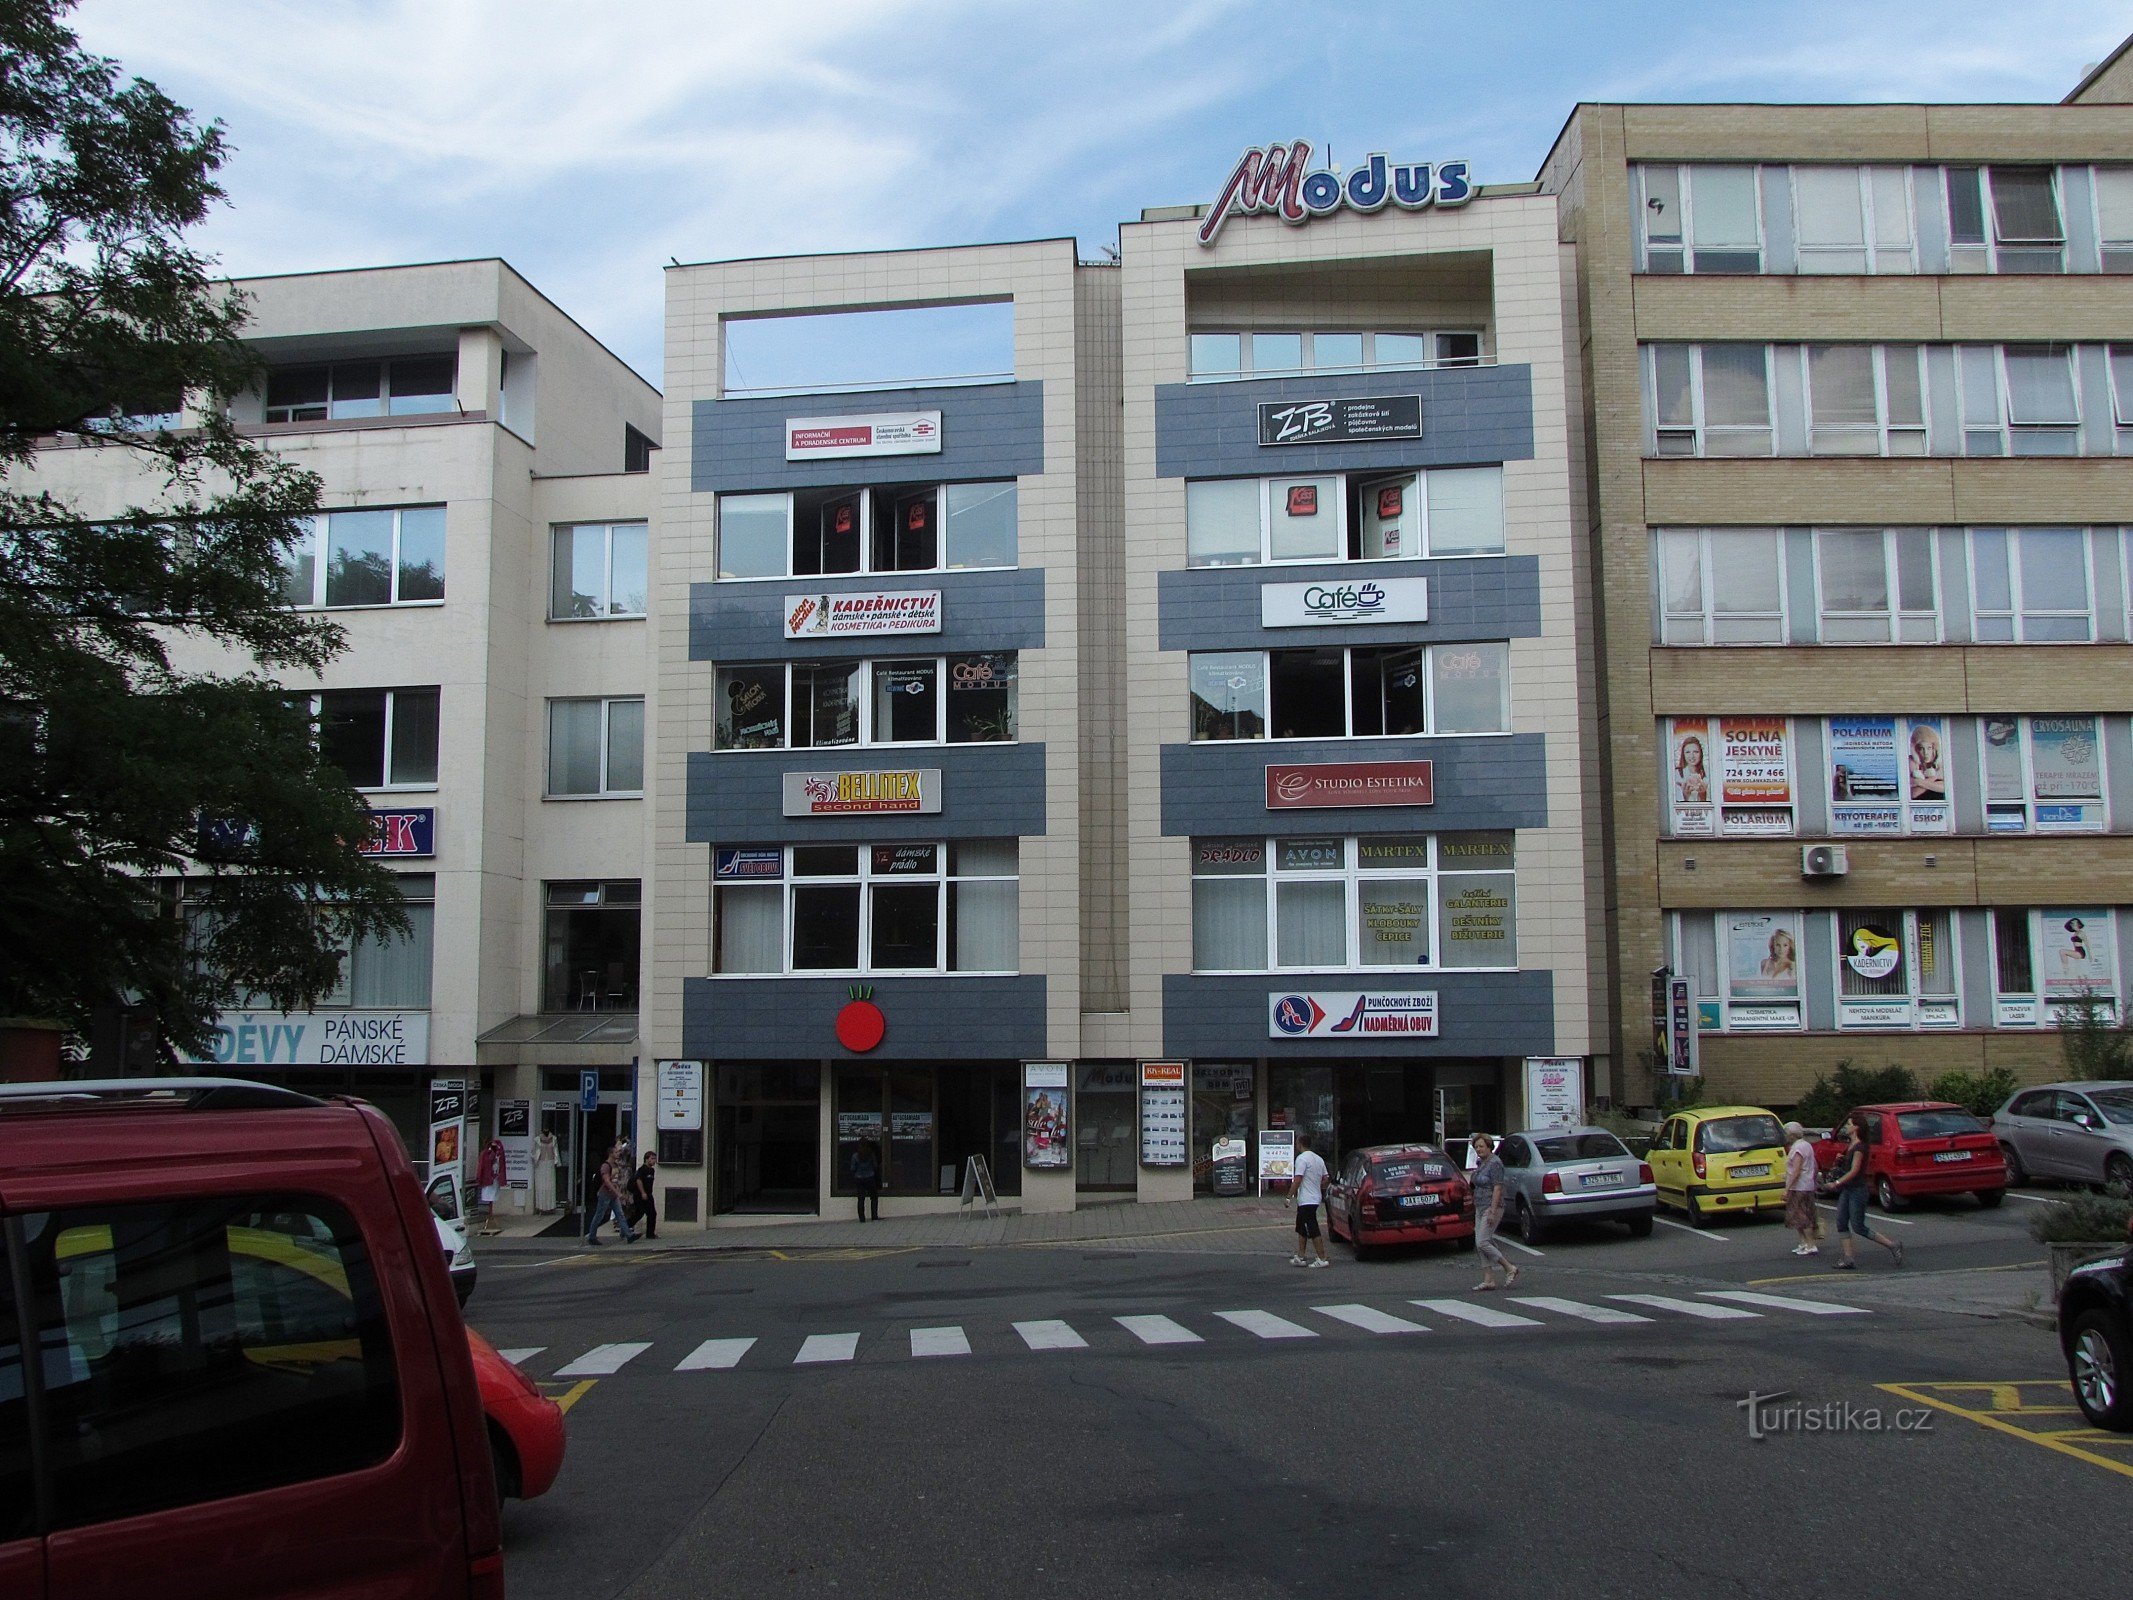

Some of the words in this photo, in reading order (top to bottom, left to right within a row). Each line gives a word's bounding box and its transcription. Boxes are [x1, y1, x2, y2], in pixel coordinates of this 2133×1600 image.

[1198, 138, 1472, 248] Modus
[1348, 403, 1375, 412] prodejna
[1381, 410, 1390, 418] šití
[1271, 402, 1333, 442] ZB
[1348, 419, 1377, 427] půjčovna
[1348, 425, 1394, 435] společenských
[1394, 423, 1418, 431] modelů
[795, 432, 831, 440] INFORMAČNÍ
[801, 438, 838, 446] PORADENSKÉ
[832, 593, 937, 612] KADEŘNICTVÍ
[1304, 584, 1358, 610] Café
[788, 598, 809, 627] salon
[791, 600, 817, 635] Modus
[832, 611, 865, 621] dámské
[871, 611, 901, 621] pánské
[907, 610, 935, 618] dětské
[830, 621, 883, 632] KOSMETIKA
[953, 662, 993, 681] Café
[1832, 727, 1892, 738] POLÁRIUM
[2032, 720, 2093, 733] CRYOSAUNA
[1725, 727, 1782, 742] SOLNÁ
[1725, 743, 1782, 756] JESKYNĚ
[838, 772, 921, 801] BELLITEX
[1315, 778, 1363, 789] STUDIO
[1367, 777, 1424, 788] ESTETIKA
[814, 802, 873, 811] second
[879, 801, 918, 809] hand
[1834, 812, 1898, 821] KRYOTERAPIE
[1913, 814, 1944, 823] ESHOP
[896, 847, 932, 858] dámské
[1286, 848, 1337, 861] AVON
[1360, 846, 1424, 857] MARTEX
[1443, 844, 1508, 856] MARTEX
[889, 858, 918, 873] prádlo
[1446, 898, 1508, 909] GALANTERIE
[1367, 918, 1421, 929] KLOBOUKY
[1452, 914, 1503, 927] DEŠTNÍKY
[1376, 929, 1412, 941] ČEPICE
[1451, 927, 1505, 940] BIŽUTERIE
[1368, 995, 1411, 1007] PUNČOCHOVÉ
[1412, 995, 1433, 1007] ZBOŽÍ
[1363, 1014, 1409, 1032] NADMĚRNÁ
[1410, 1016, 1432, 1031] OBUV
[196, 1013, 306, 1063] DĚVY
[325, 1014, 402, 1039] PÁNSKÉ
[320, 1039, 405, 1064] DÁMSKÉ
[1082, 1066, 1133, 1089] Modu
[434, 1096, 460, 1114] ZB
[1424, 1164, 1443, 1172] BEAT
